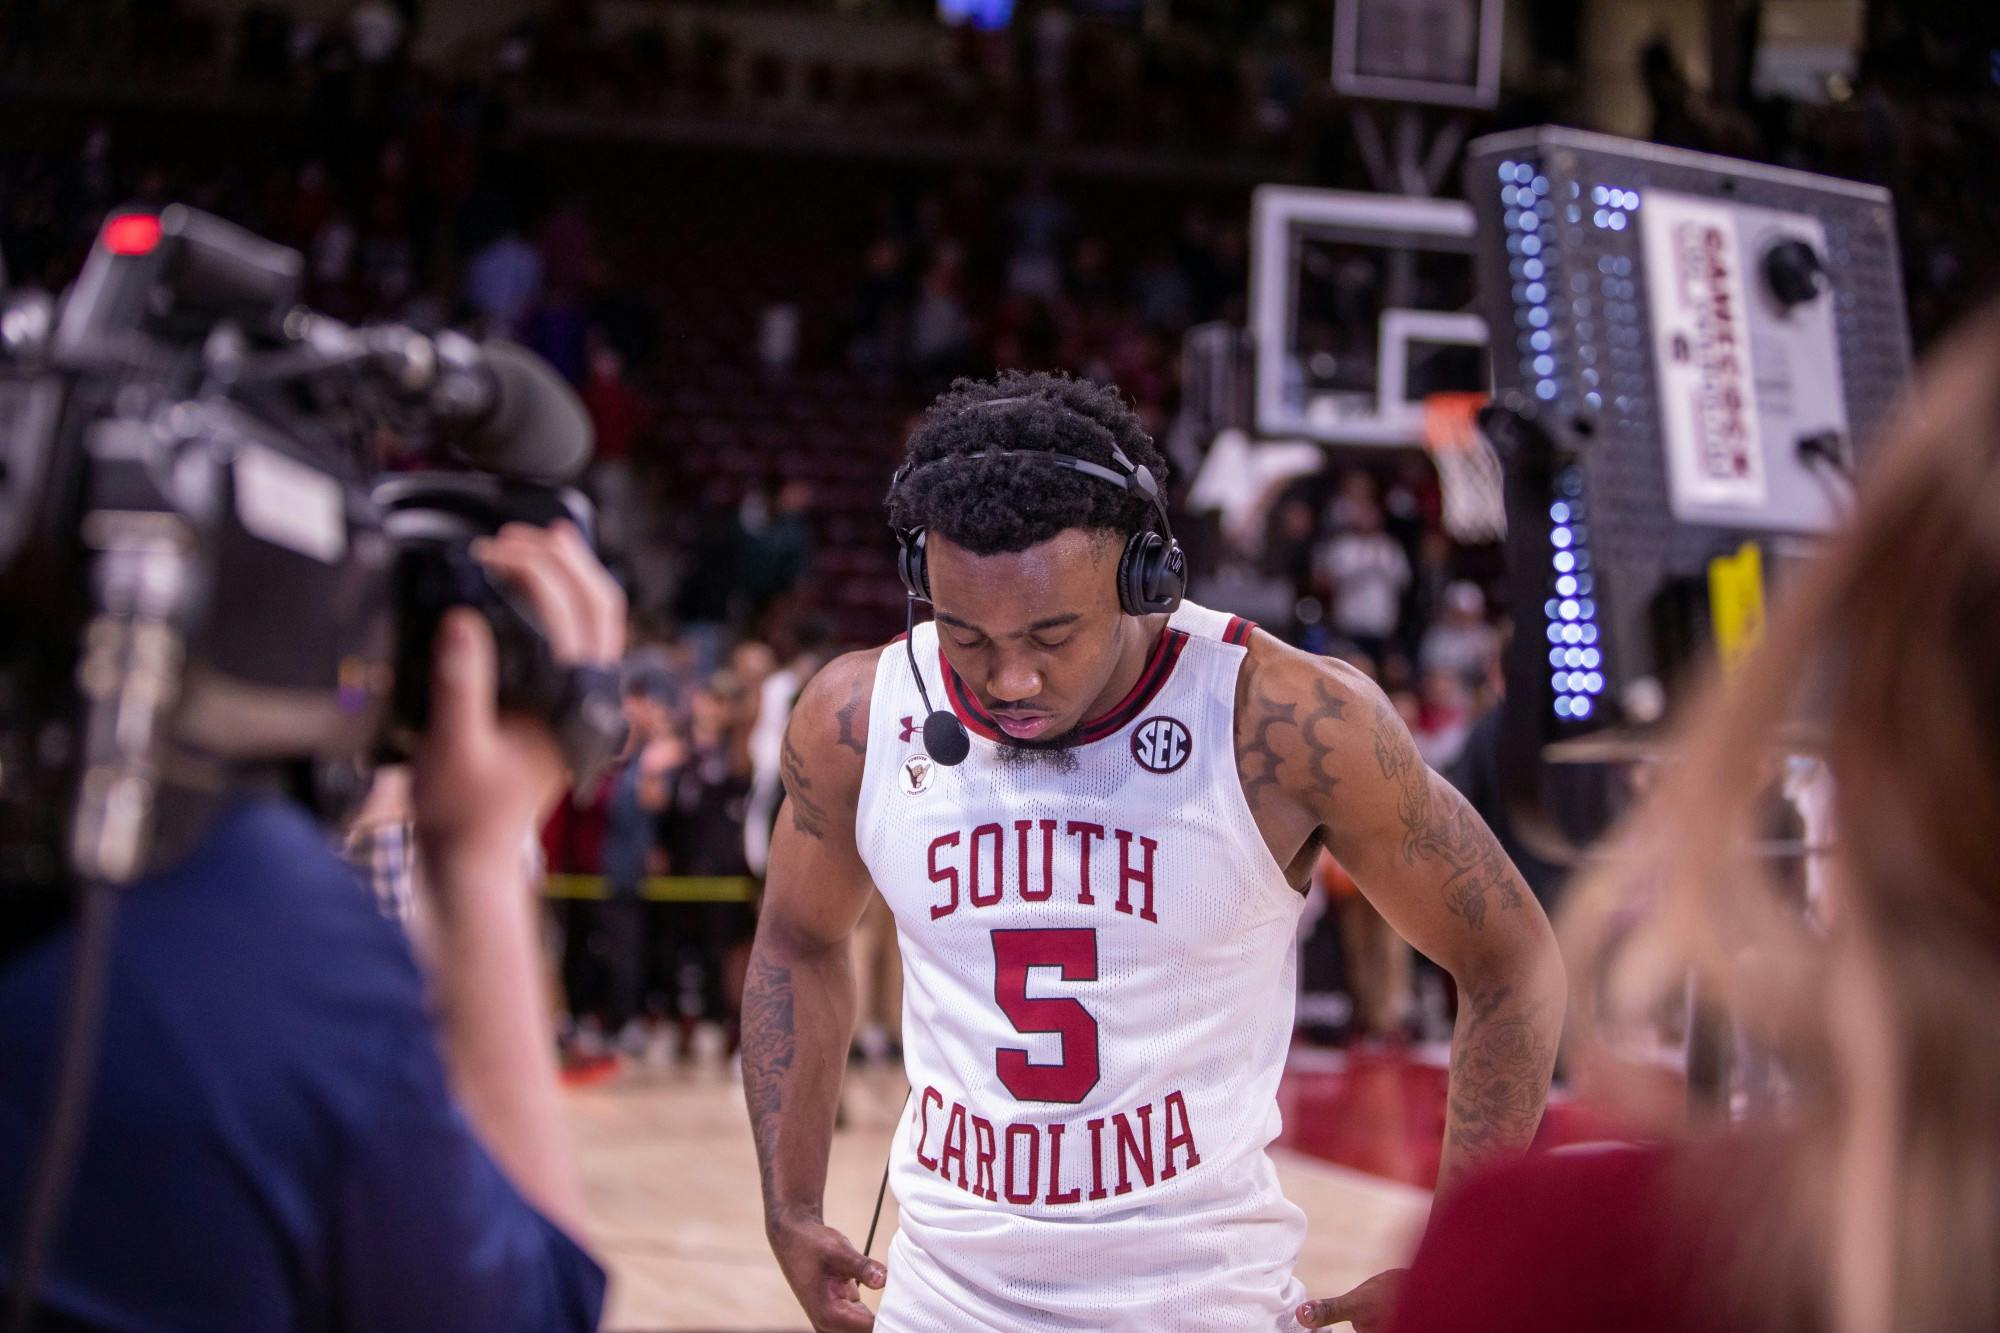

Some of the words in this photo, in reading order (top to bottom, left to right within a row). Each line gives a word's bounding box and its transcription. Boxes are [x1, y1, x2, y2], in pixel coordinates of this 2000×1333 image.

[1137, 720, 1187, 769] SEC
[927, 819, 1158, 924] SOUTH
[990, 927, 1100, 1104] 5
[917, 1085, 1201, 1206] CAROLINA
